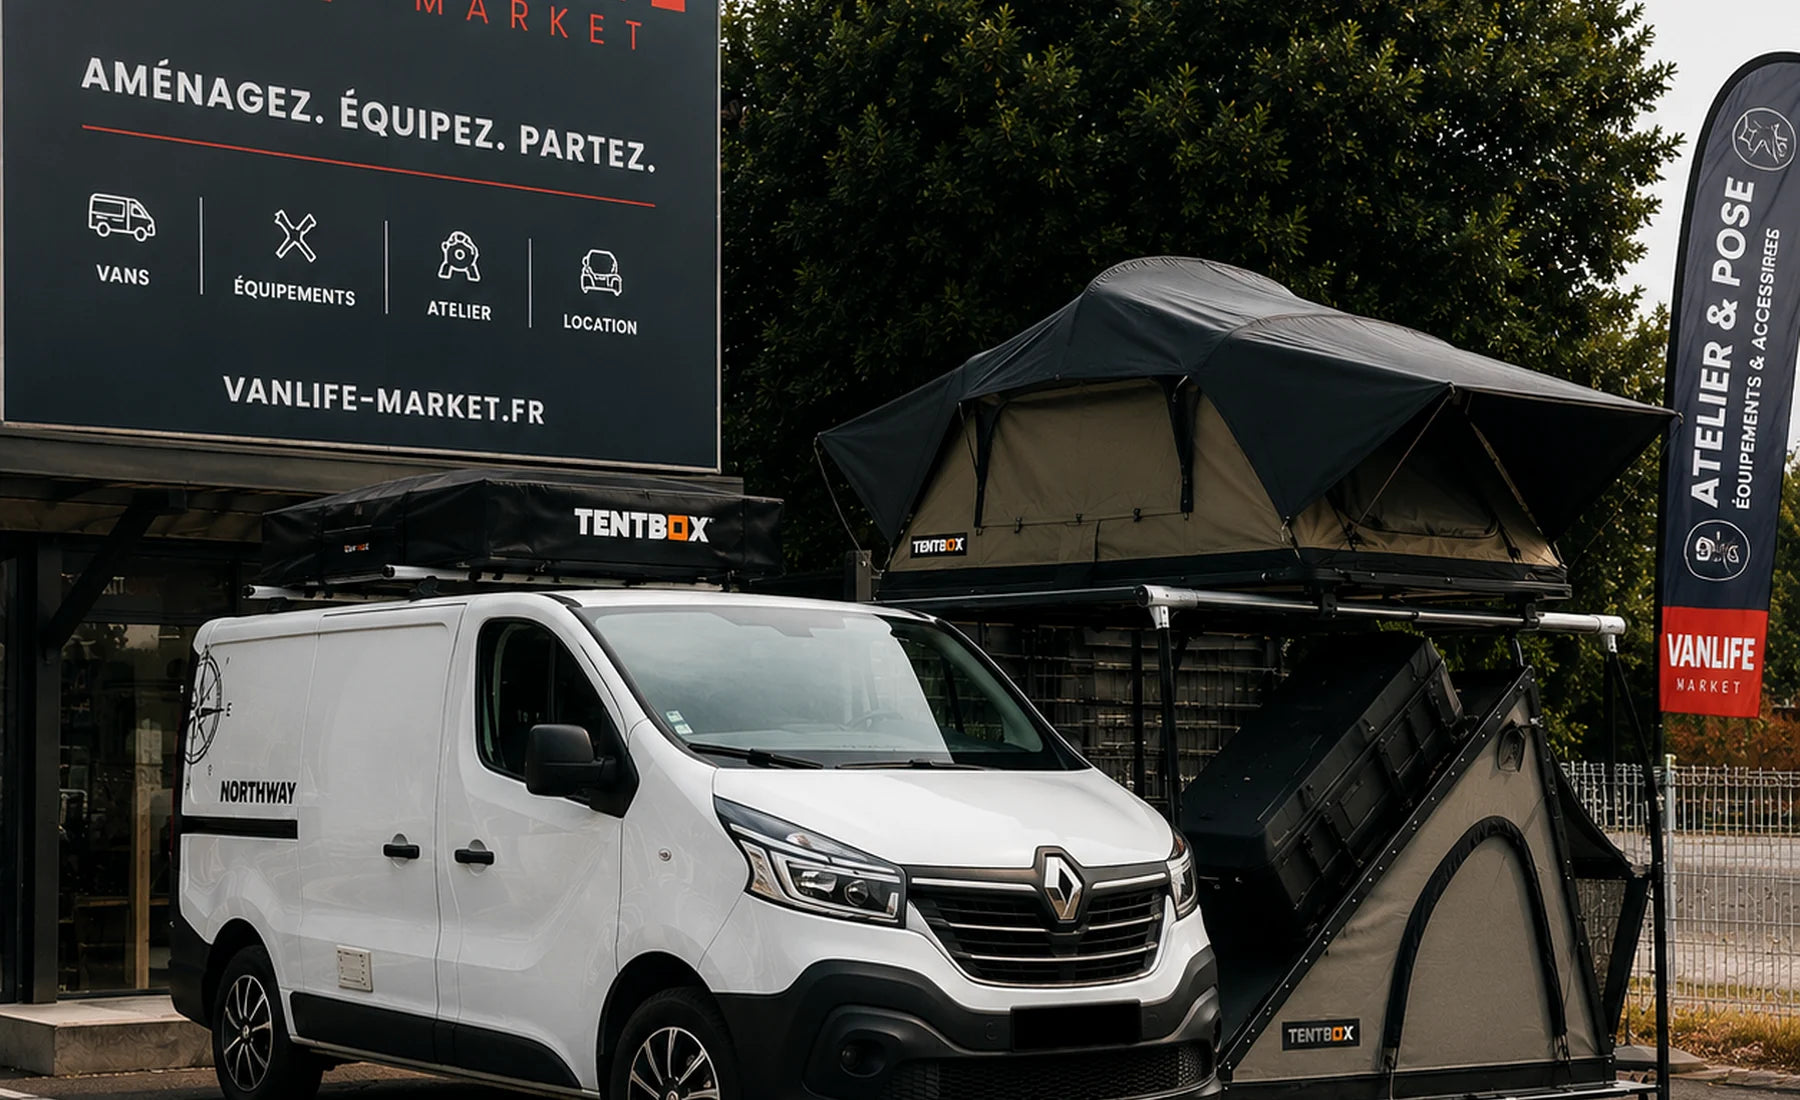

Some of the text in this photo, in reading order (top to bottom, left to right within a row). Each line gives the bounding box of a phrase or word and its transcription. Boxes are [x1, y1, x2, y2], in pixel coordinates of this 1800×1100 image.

[82, 57, 656, 173] AMÉNAGEZ. ÉQUIPEZ. PARTEZ.
[96, 263, 150, 286] VANS
[234, 274, 356, 307] ÉQUIPEMENTS
[427, 300, 492, 321] ATELIER
[563, 313, 637, 336] LOCATION
[1691, 177, 1754, 508] ATELIER & POSE
[1749, 356, 1765, 371] &
[223, 375, 545, 425] VANLIFE-MARKET.FR
[574, 508, 709, 543] TENTBOX
[1667, 633, 1756, 671] VANLIFE
[1676, 678, 1741, 695] MARKET
[219, 780, 297, 805] NORTHWAY
[1287, 1025, 1354, 1044] TENTBOX
